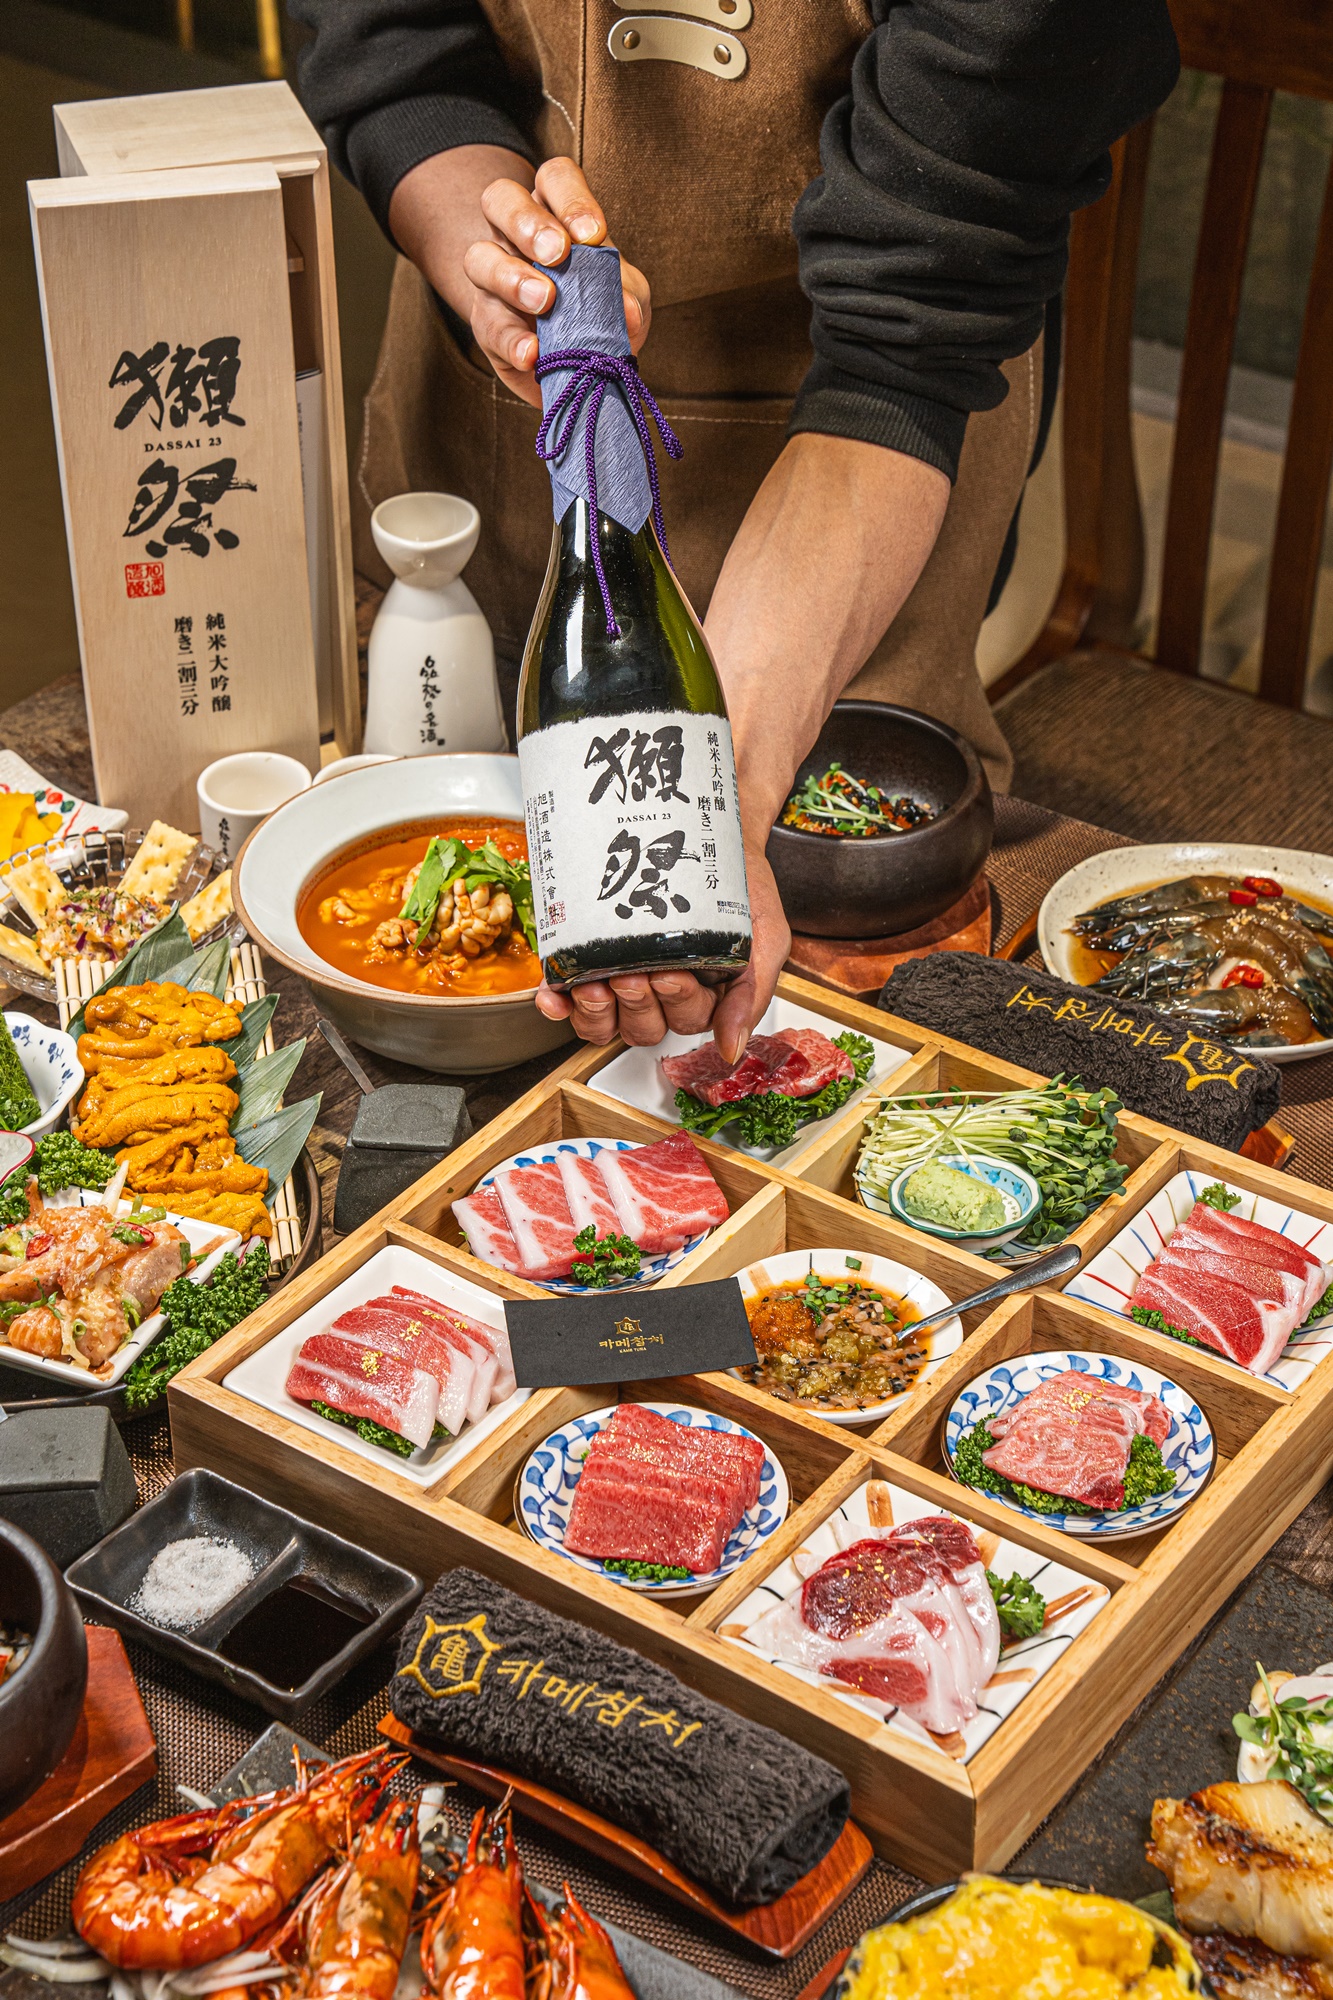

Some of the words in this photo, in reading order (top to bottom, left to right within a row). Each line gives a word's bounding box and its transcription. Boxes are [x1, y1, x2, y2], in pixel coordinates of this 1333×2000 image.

[144, 439, 201, 452] DASSAI
[208, 437, 222, 447] 23
[174, 616, 199, 716] 磨き二割三分
[617, 815, 657, 824] DASSAI
[697, 796, 719, 890] 磨き二割三分
